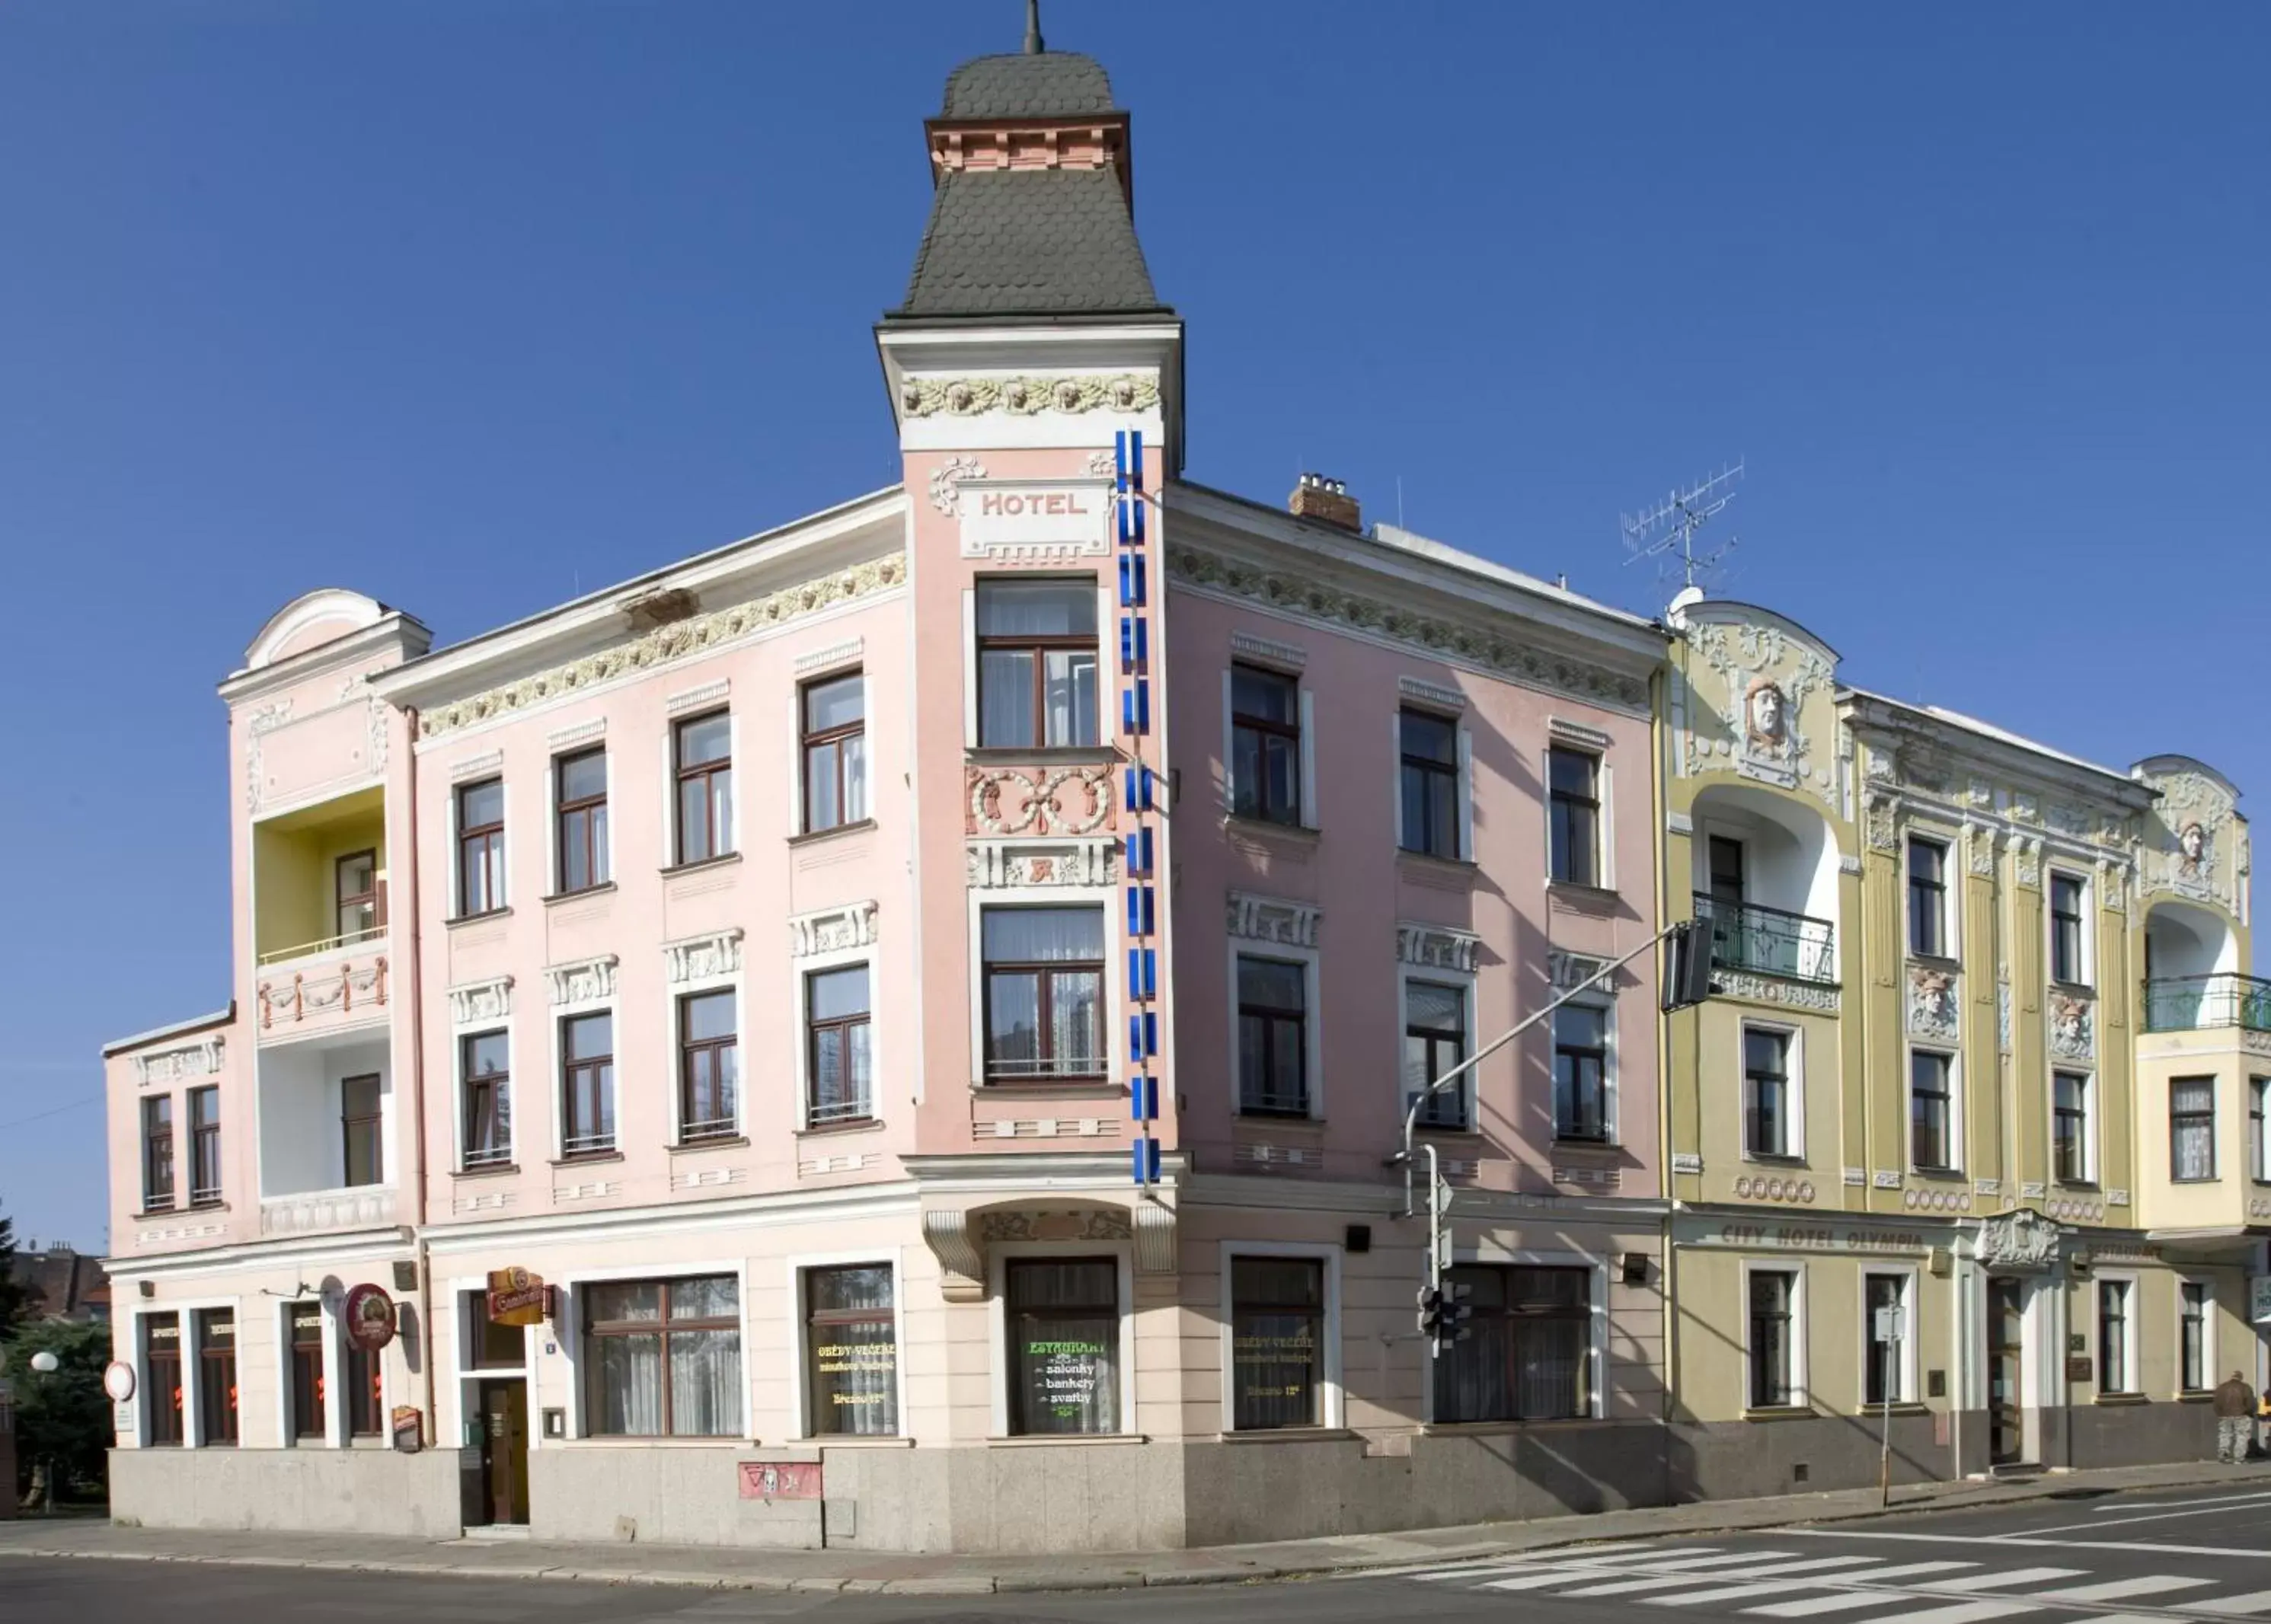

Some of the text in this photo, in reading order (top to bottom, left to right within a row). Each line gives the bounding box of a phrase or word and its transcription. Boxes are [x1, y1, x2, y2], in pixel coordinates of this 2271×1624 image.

[982, 493, 1088, 515] HOTEL
[1720, 1224, 1924, 1251] CITY HOTEL OLYMPIA
[1046, 1364, 1094, 1375] salonky
